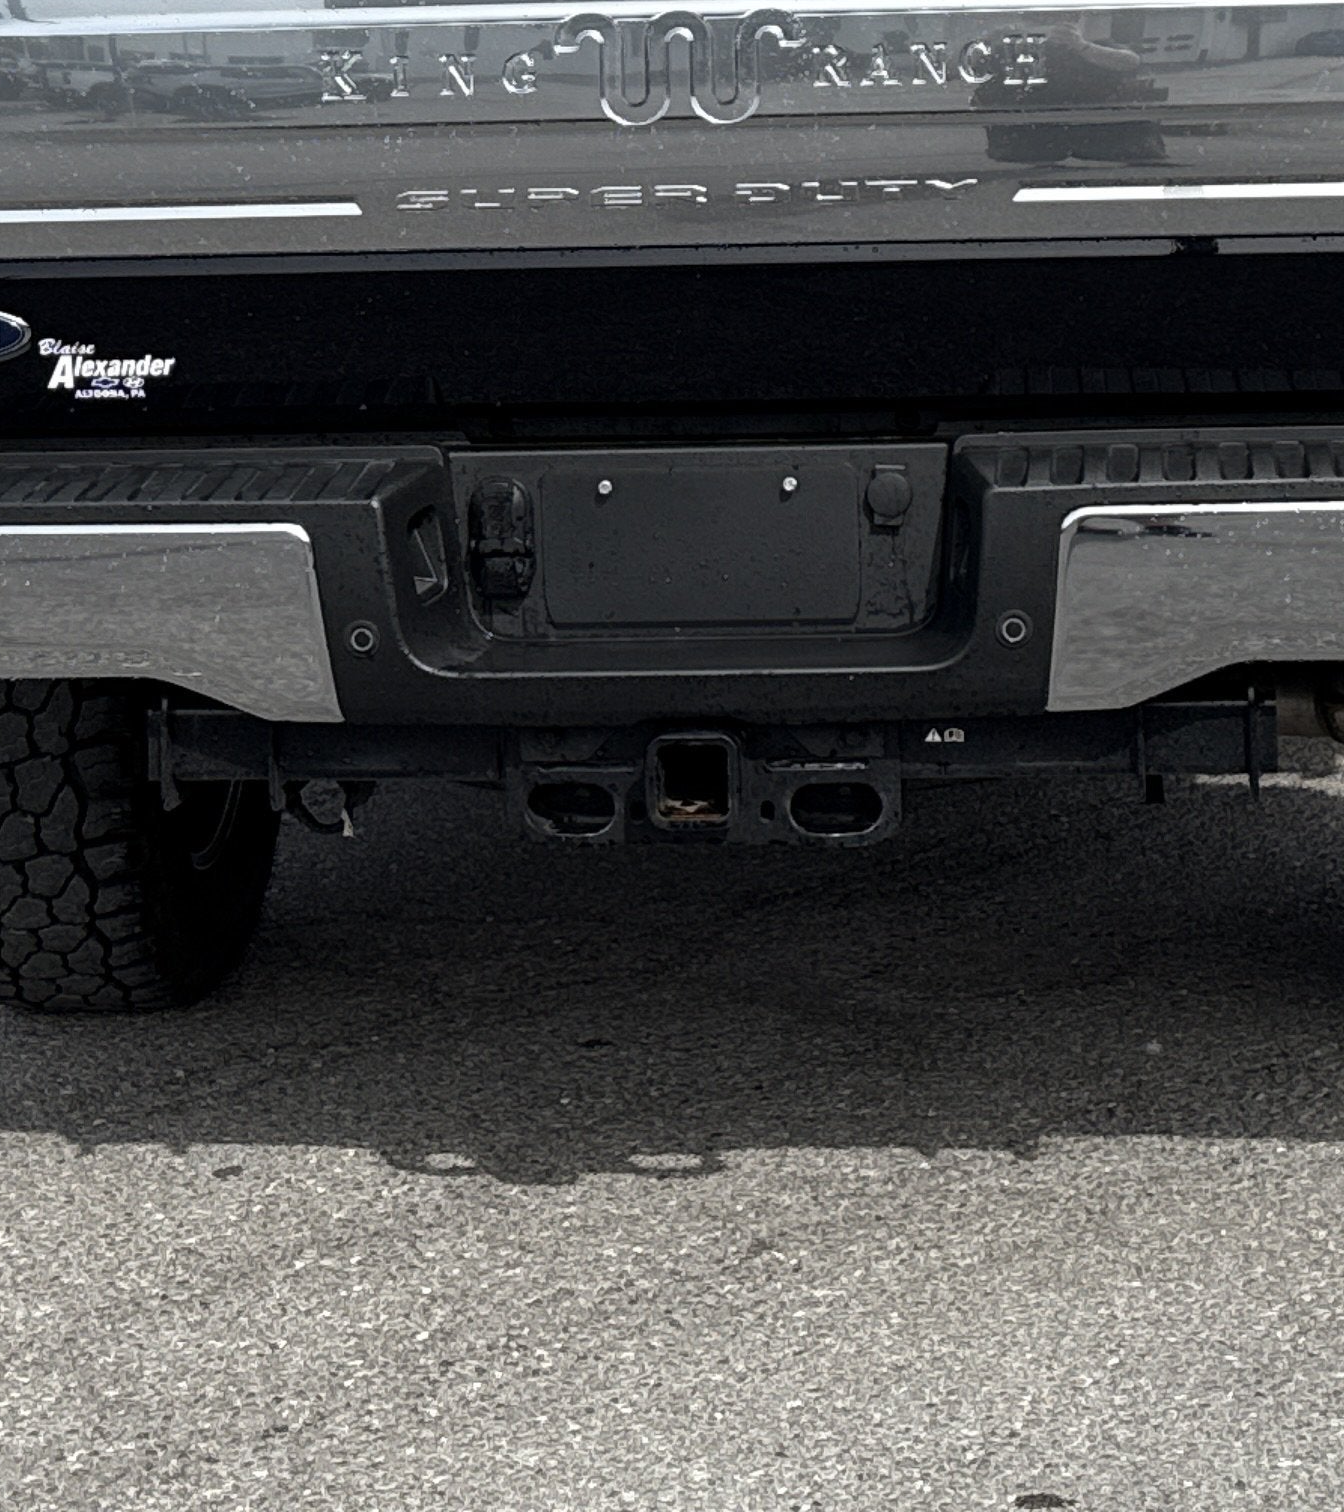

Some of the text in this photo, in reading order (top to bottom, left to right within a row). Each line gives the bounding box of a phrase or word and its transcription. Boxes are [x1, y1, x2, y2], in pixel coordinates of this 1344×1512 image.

[320, 50, 537, 101] KING
[812, 34, 1048, 88] RANCH
[396, 178, 979, 212] SUPER DUTY
[38, 338, 96, 356] Blaise
[47, 354, 176, 389] Alexander
